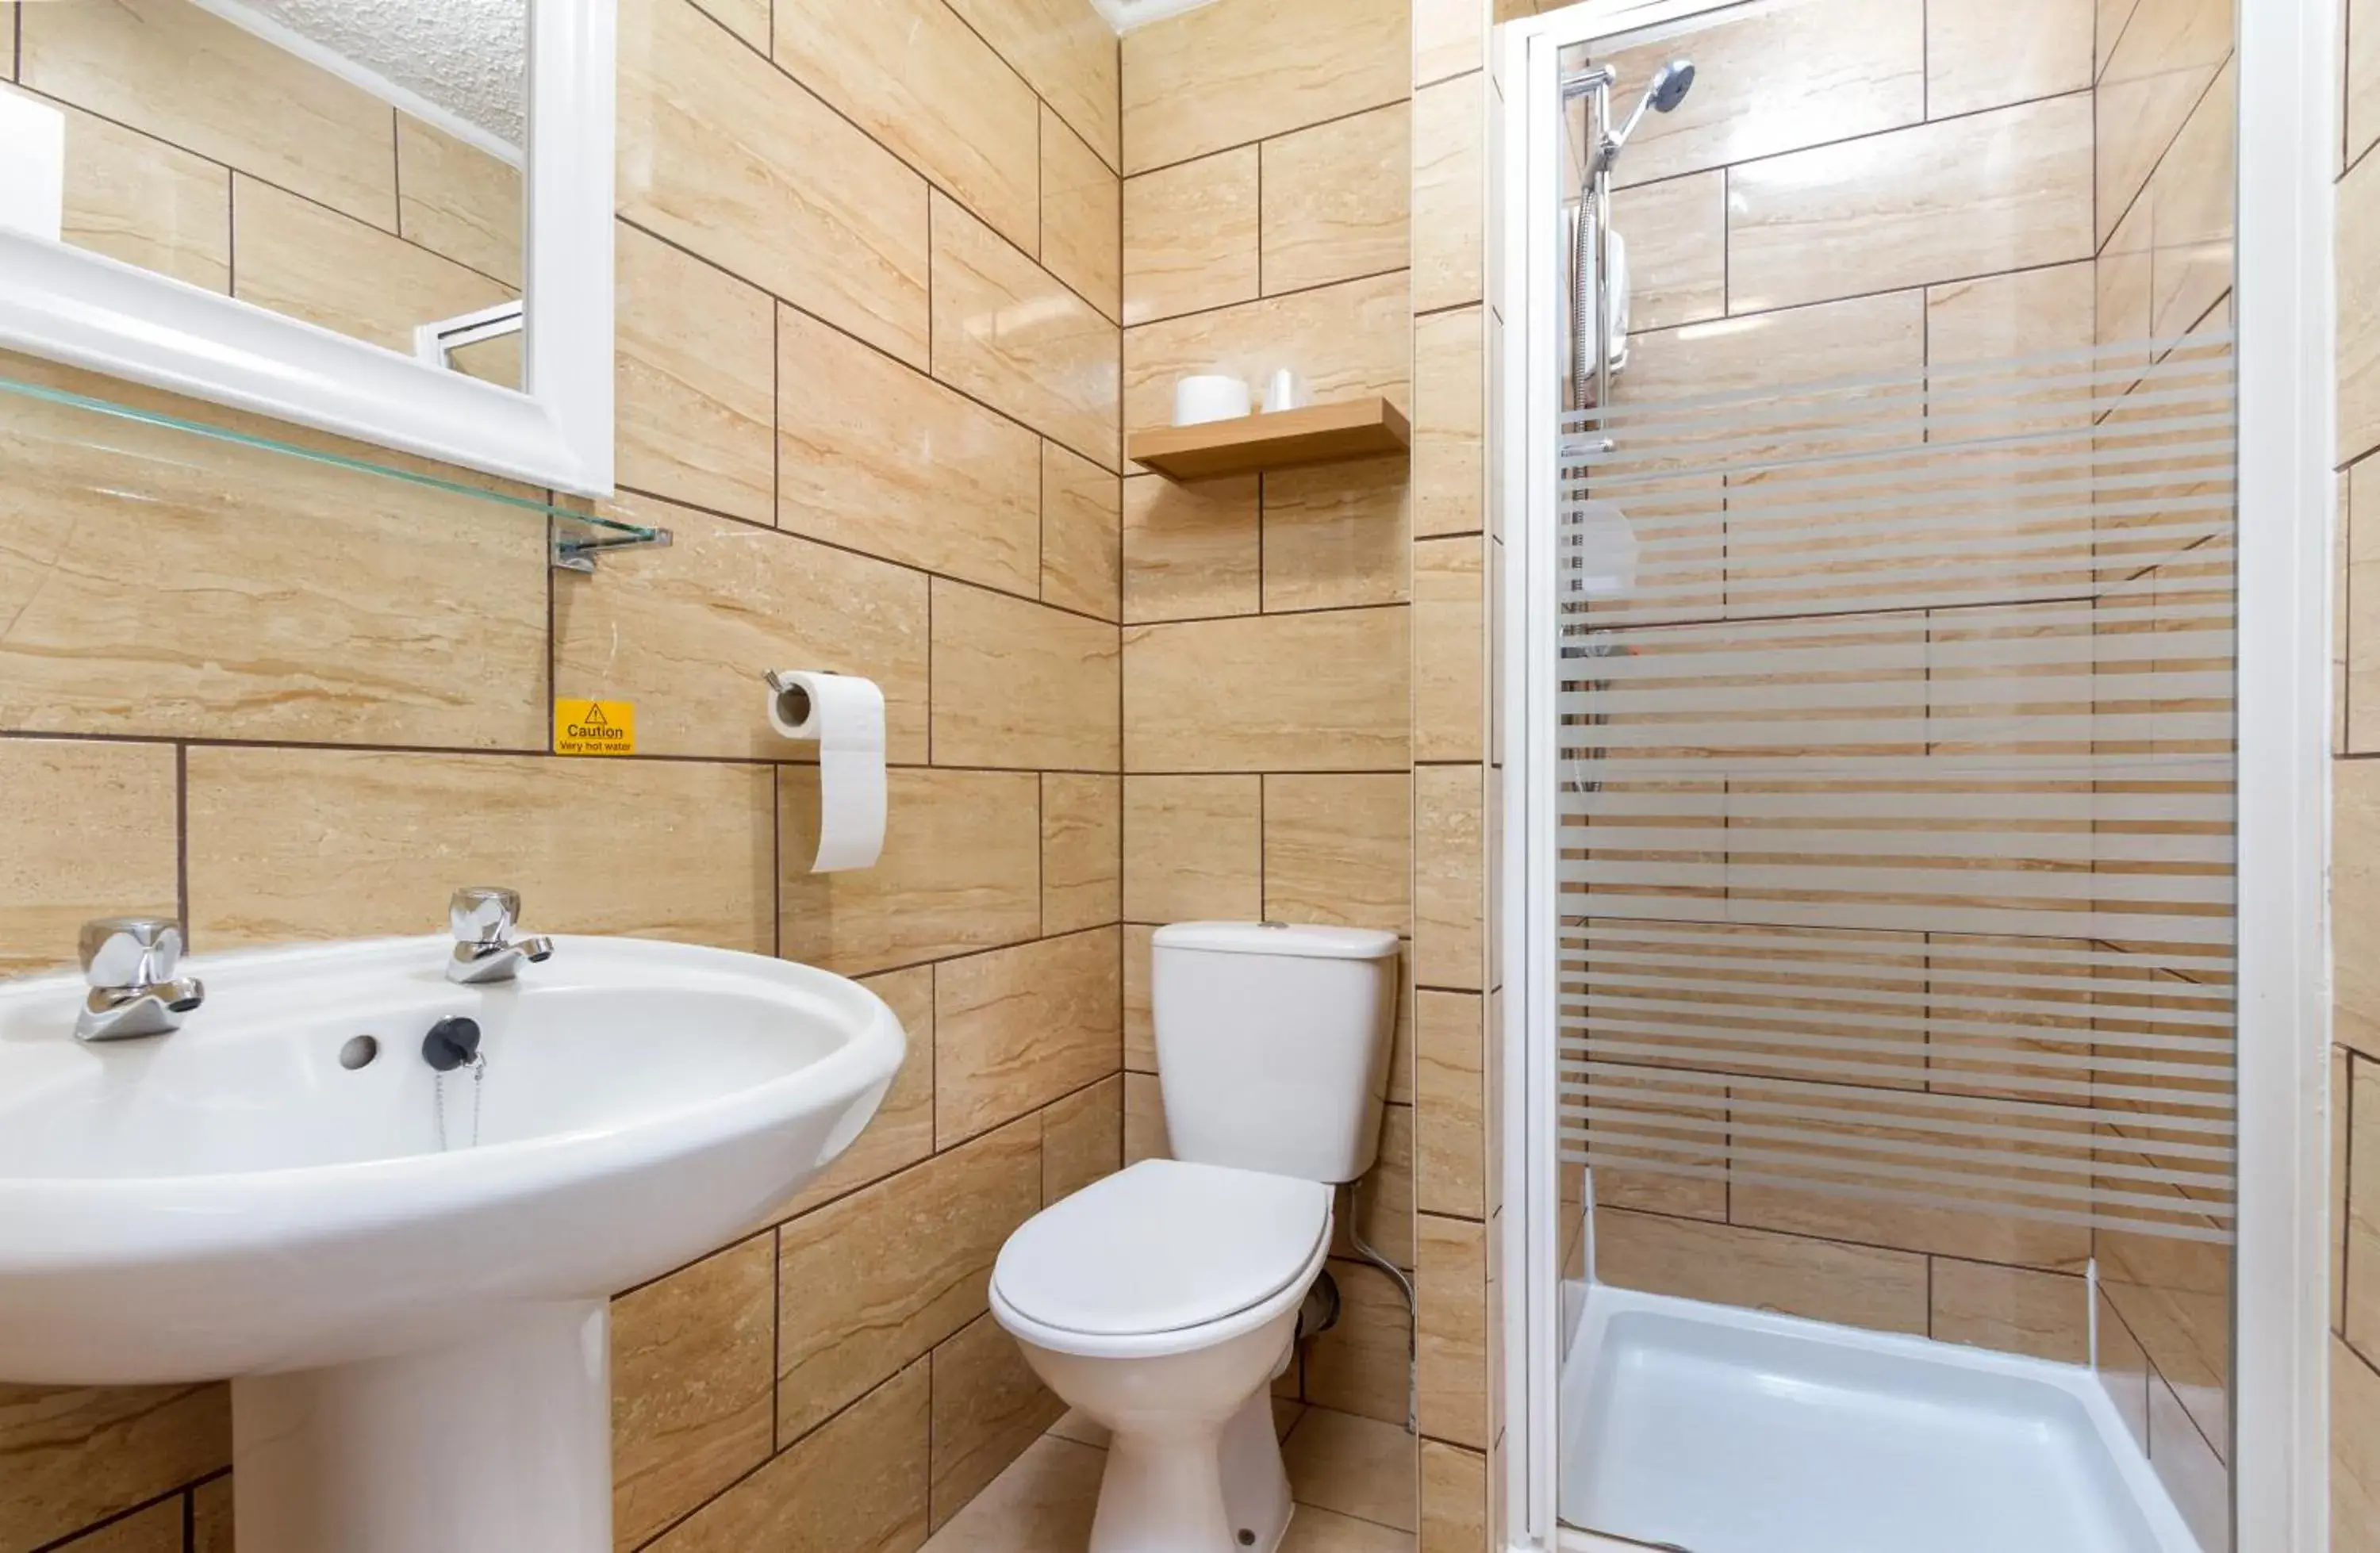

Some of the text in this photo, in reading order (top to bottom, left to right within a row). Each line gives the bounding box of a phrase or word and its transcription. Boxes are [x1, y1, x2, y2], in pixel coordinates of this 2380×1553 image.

[567, 723, 623, 738] Caution
[559, 740, 631, 752] Very hot water
